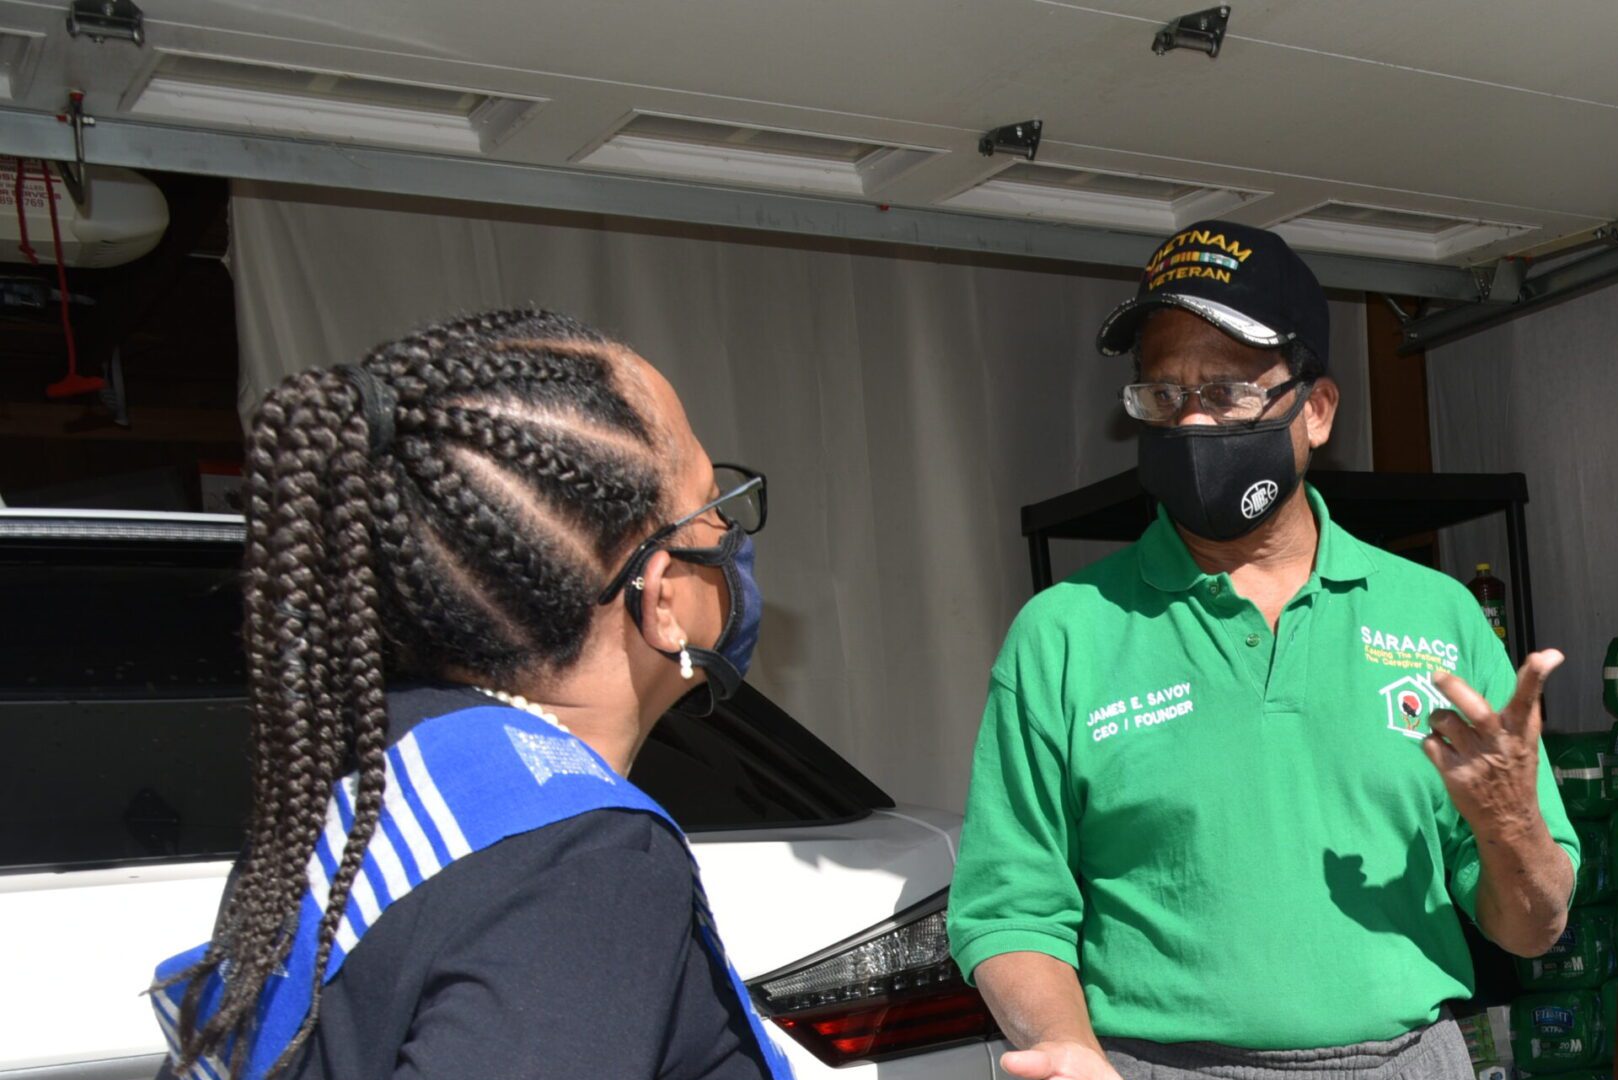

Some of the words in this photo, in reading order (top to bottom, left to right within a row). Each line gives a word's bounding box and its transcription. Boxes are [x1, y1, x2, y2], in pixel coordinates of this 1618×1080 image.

[1146, 230, 1253, 271] VIETNAM
[1149, 266, 1231, 290] VETERAN
[1360, 625, 1459, 662] SARAACC
[1382, 658, 1423, 669] Caregiver
[1087, 700, 1127, 727] JAMES
[1146, 682, 1191, 706] SAVOY
[1092, 721, 1119, 742] CEO
[1134, 699, 1194, 728] FOUNDER
[1571, 956, 1584, 971] M
[1559, 1041, 1570, 1050] 20
[1569, 1038, 1583, 1053] M
